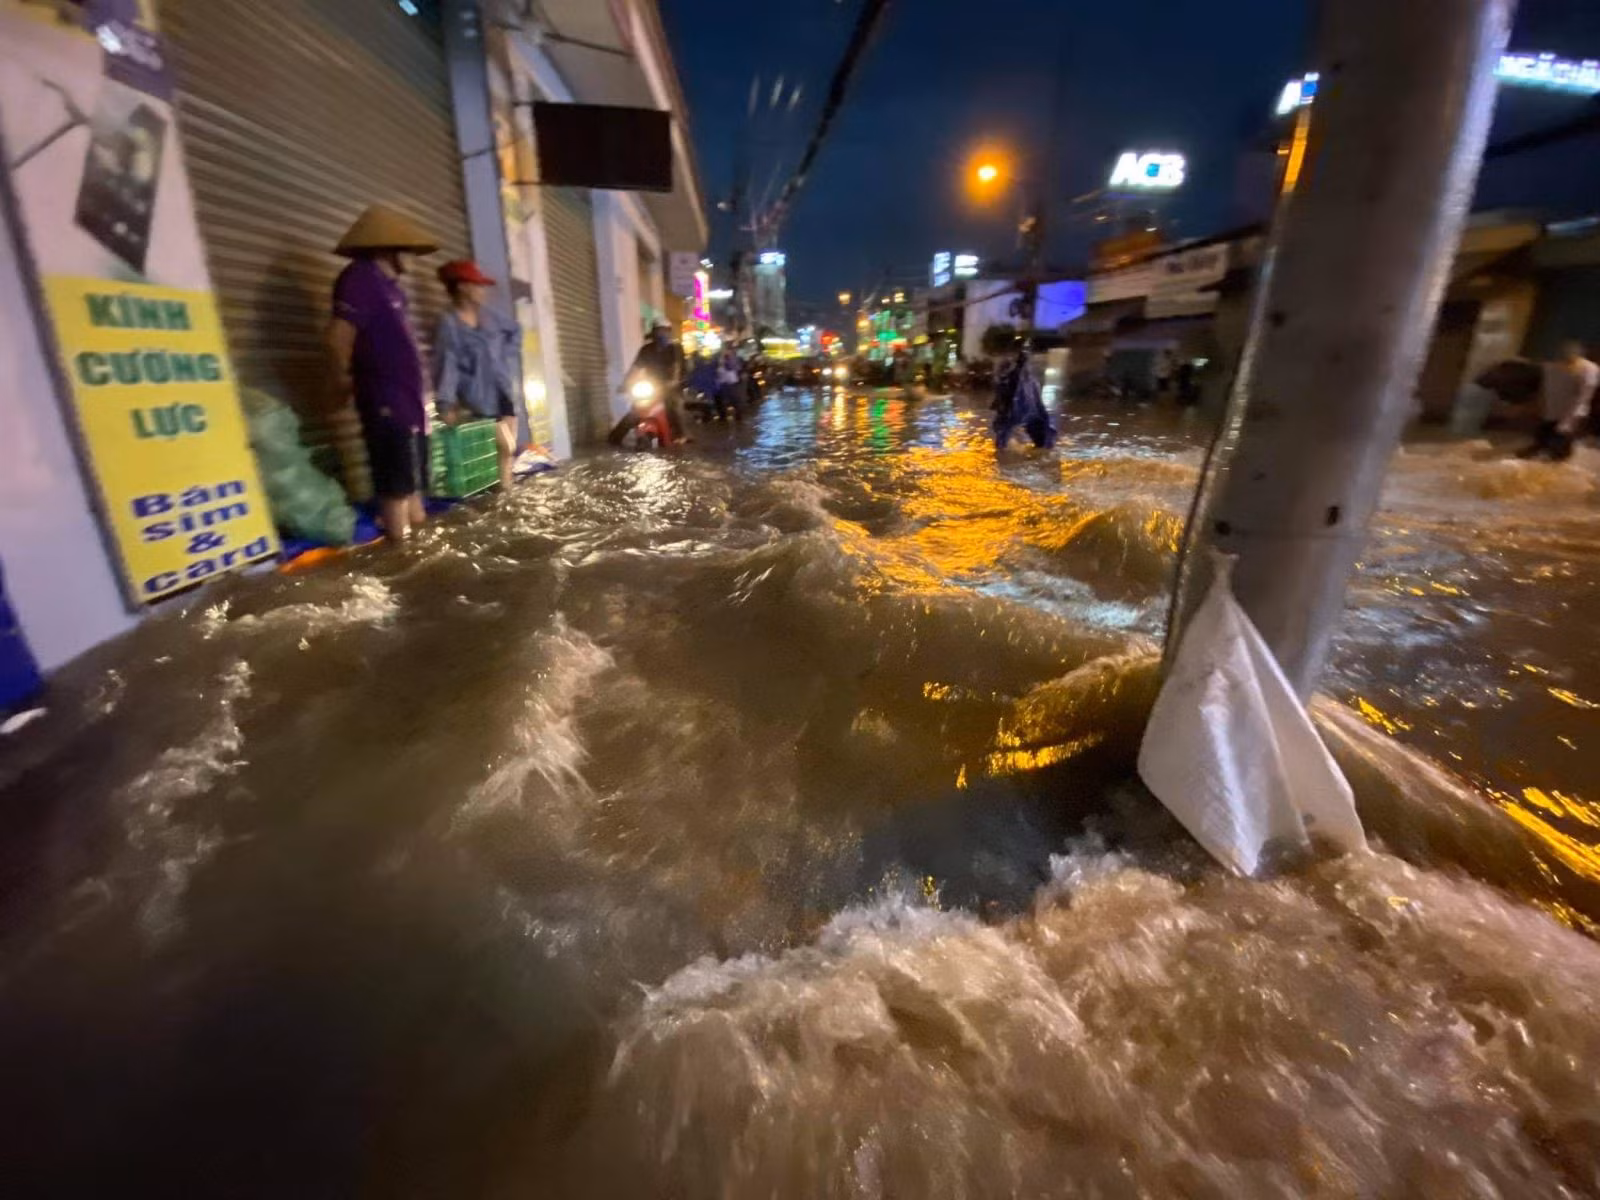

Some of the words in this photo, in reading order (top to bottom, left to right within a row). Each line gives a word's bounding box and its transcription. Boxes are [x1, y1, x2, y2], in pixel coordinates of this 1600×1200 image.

[1109, 152, 1185, 187] ACB
[84, 291, 193, 332] KÍNH
[132, 480, 246, 518] Bán
[186, 531, 225, 555] &
